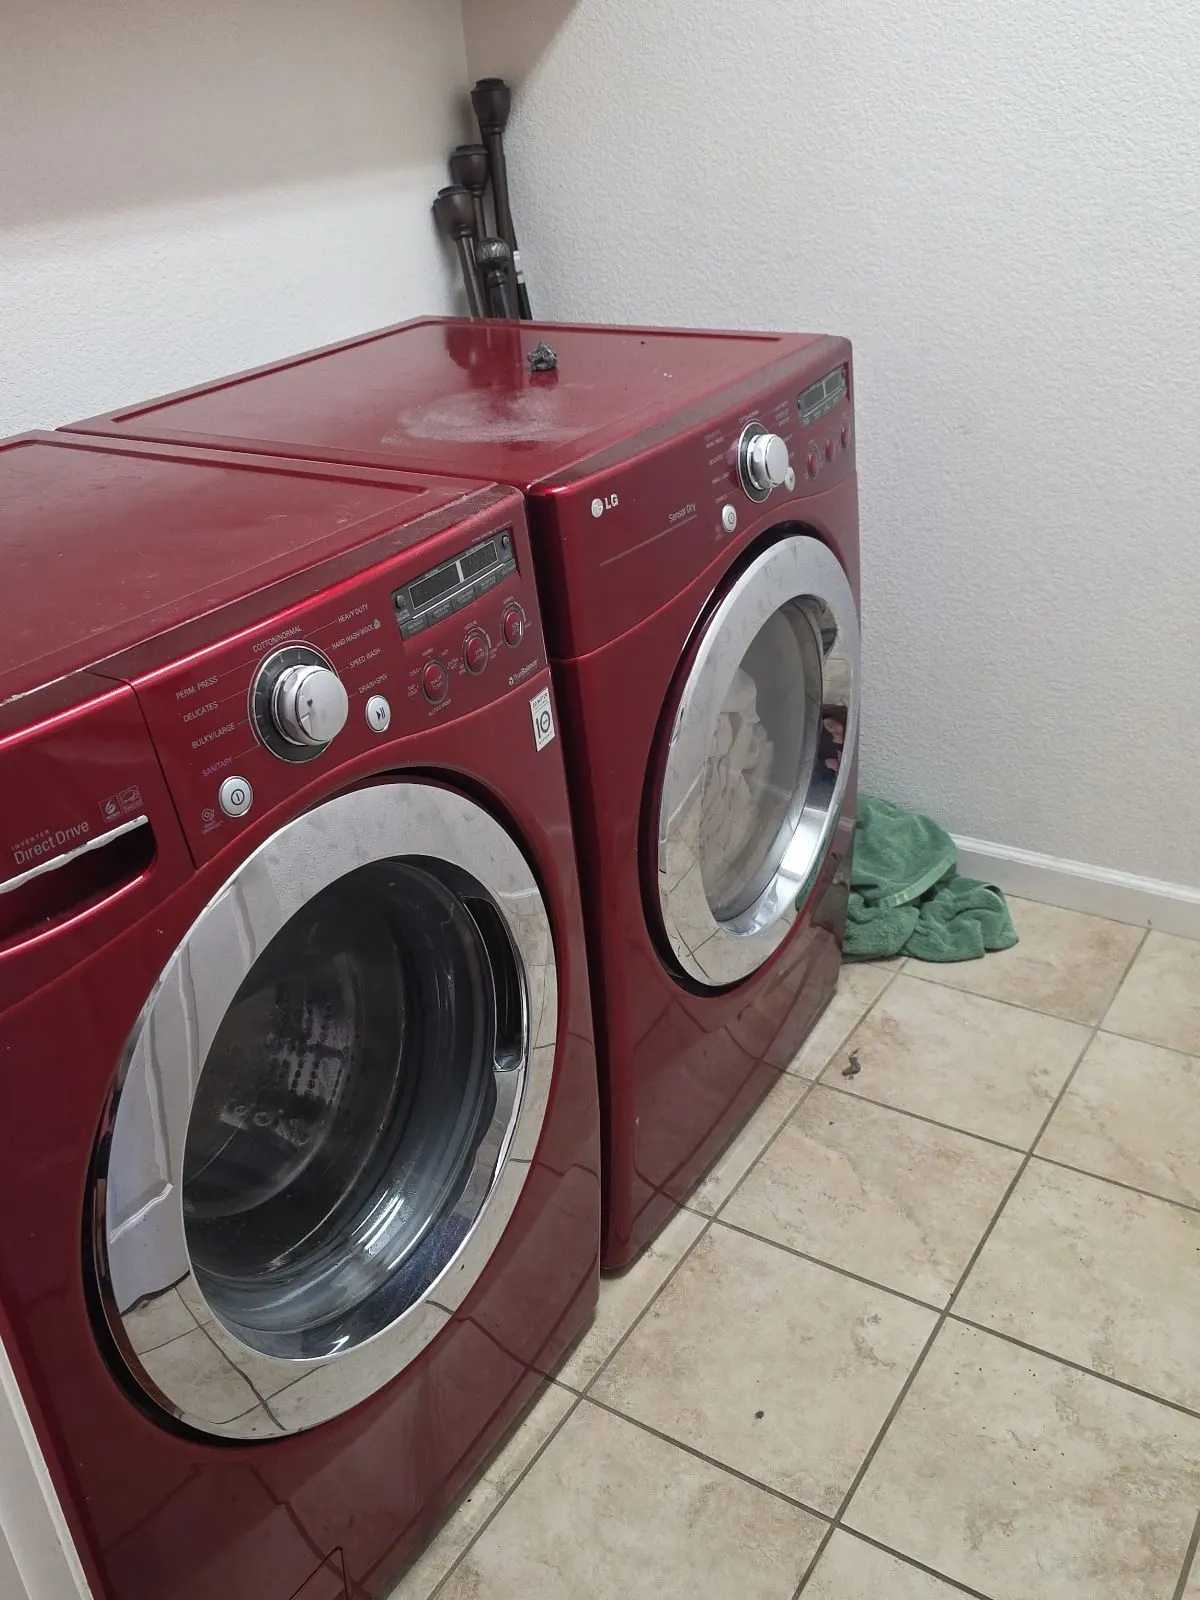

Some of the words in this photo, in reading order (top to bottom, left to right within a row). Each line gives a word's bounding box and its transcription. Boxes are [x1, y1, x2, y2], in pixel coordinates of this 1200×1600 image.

[604, 493, 619, 510] LG
[668, 507, 687, 521] Sensor
[337, 609, 356, 624] HEAVY
[355, 603, 369, 618] DUTY
[252, 625, 303, 653] COTTON/NORMAL
[331, 636, 347, 650] HAND
[349, 655, 367, 669] SPEED
[366, 648, 381, 661] WASH
[175, 686, 196, 701] PERM.
[197, 675, 218, 691] PRESS
[183, 701, 219, 722] DELICATES
[191, 722, 236, 749] BULKY/LARGE
[202, 756, 233, 777] SANITARY
[14, 837, 56, 865] Direct
[55, 820, 90, 844] Drive
